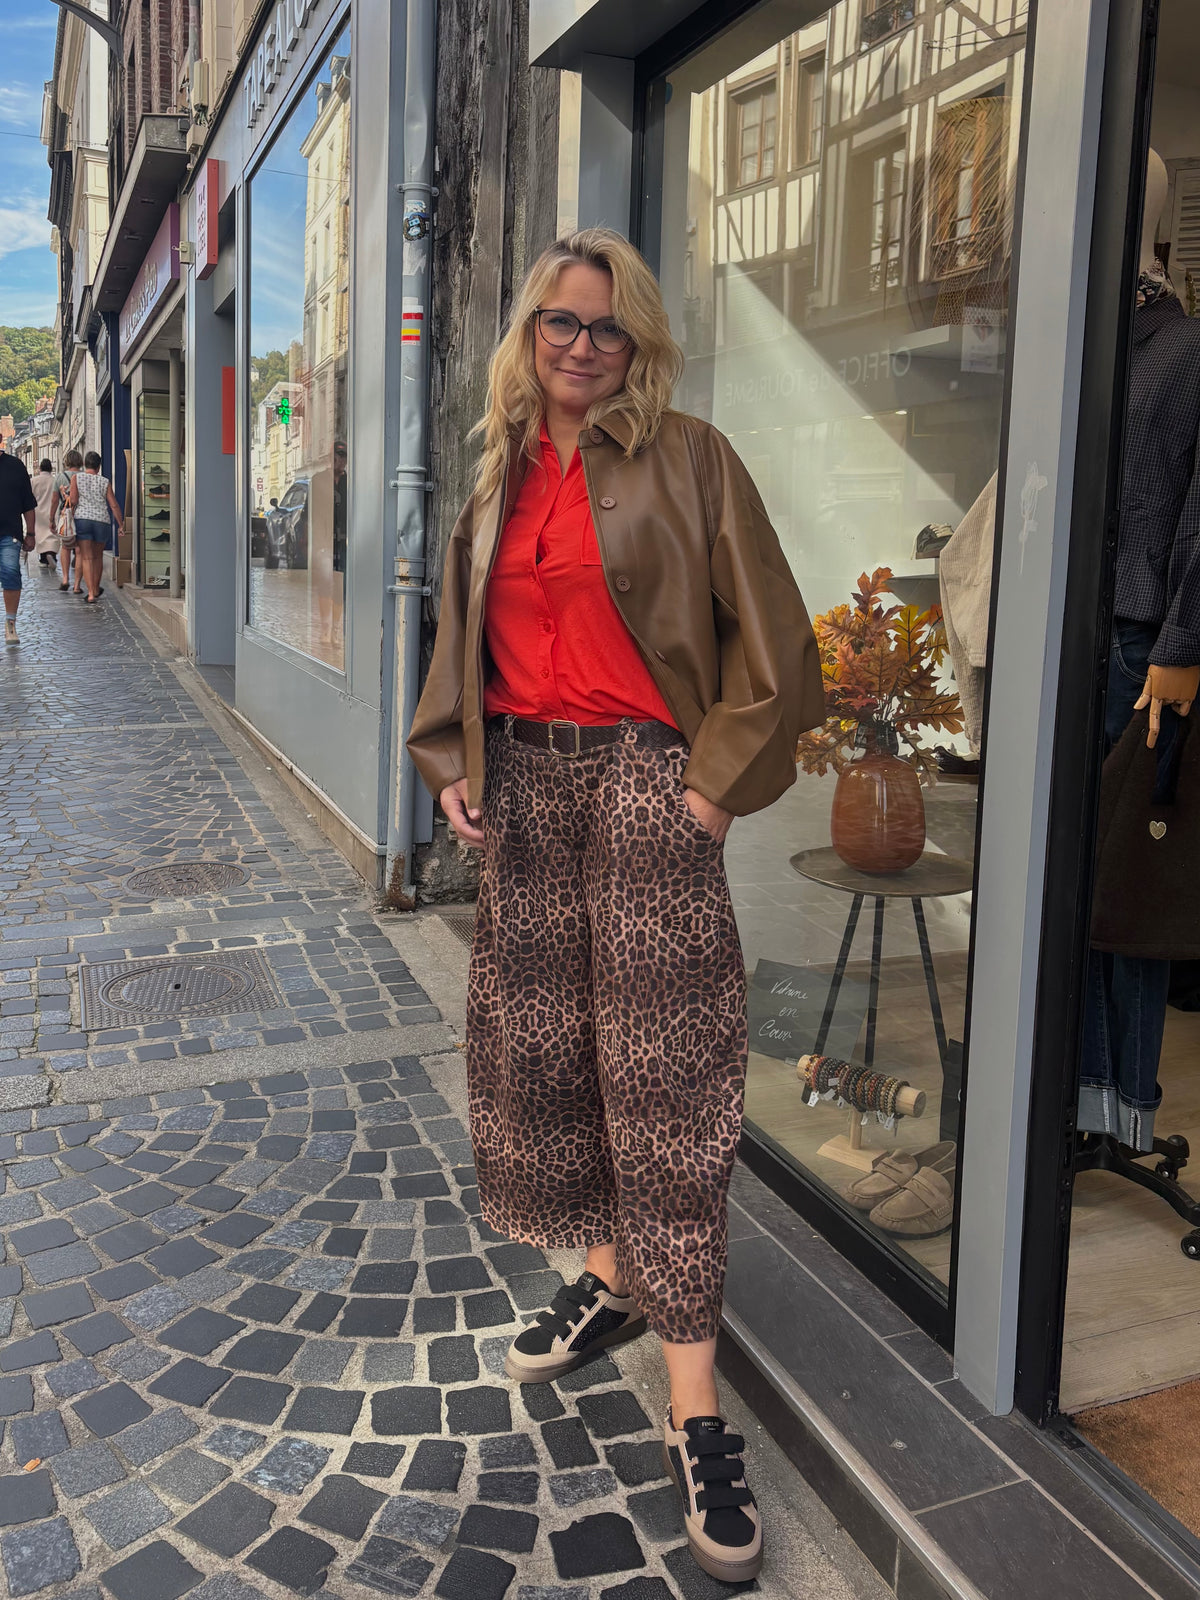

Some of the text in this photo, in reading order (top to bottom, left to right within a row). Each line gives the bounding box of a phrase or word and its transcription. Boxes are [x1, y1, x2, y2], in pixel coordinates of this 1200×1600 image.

[243, 23, 276, 128] TAPE
[769, 976, 808, 999] Vitrine
[779, 1006, 799, 1018] en
